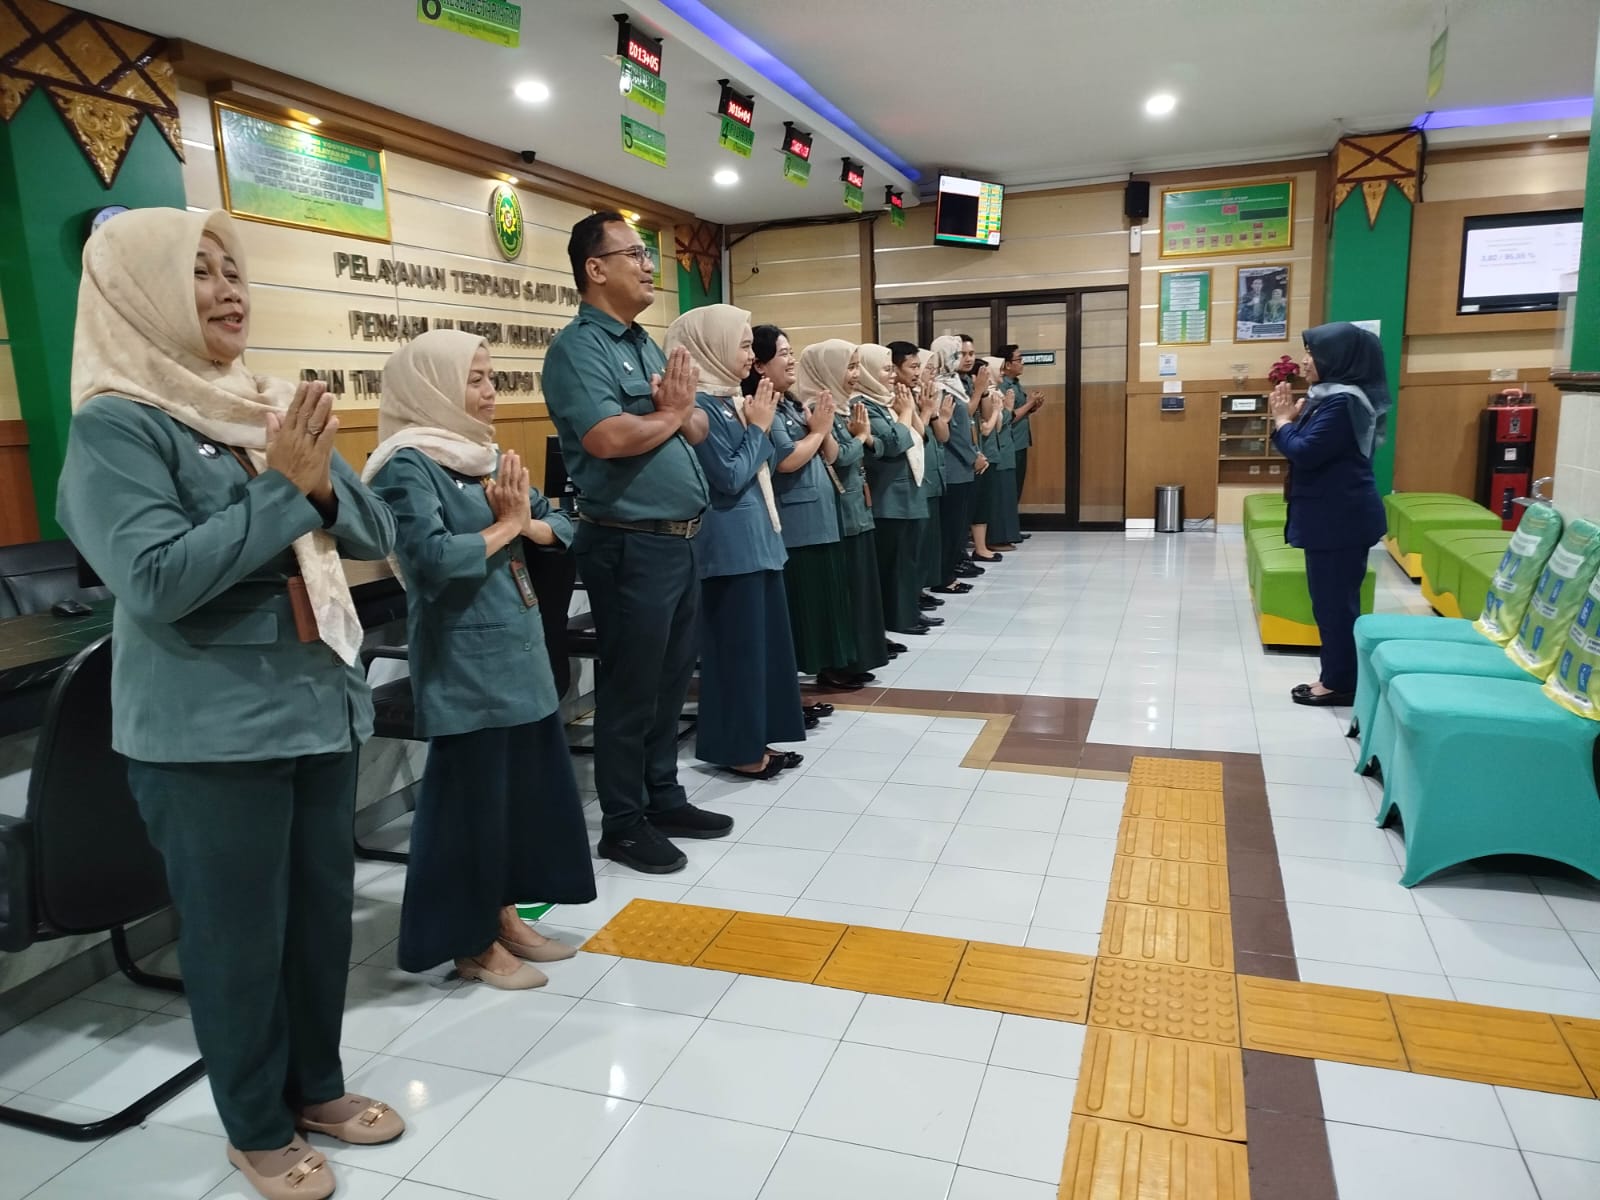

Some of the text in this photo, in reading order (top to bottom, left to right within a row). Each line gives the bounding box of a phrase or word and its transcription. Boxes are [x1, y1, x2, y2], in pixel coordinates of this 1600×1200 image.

[624, 121, 634, 149] 5
[333, 251, 447, 291] PELAYANAN
[450, 270, 521, 299] TERPADU
[522, 281, 558, 305] SATU
